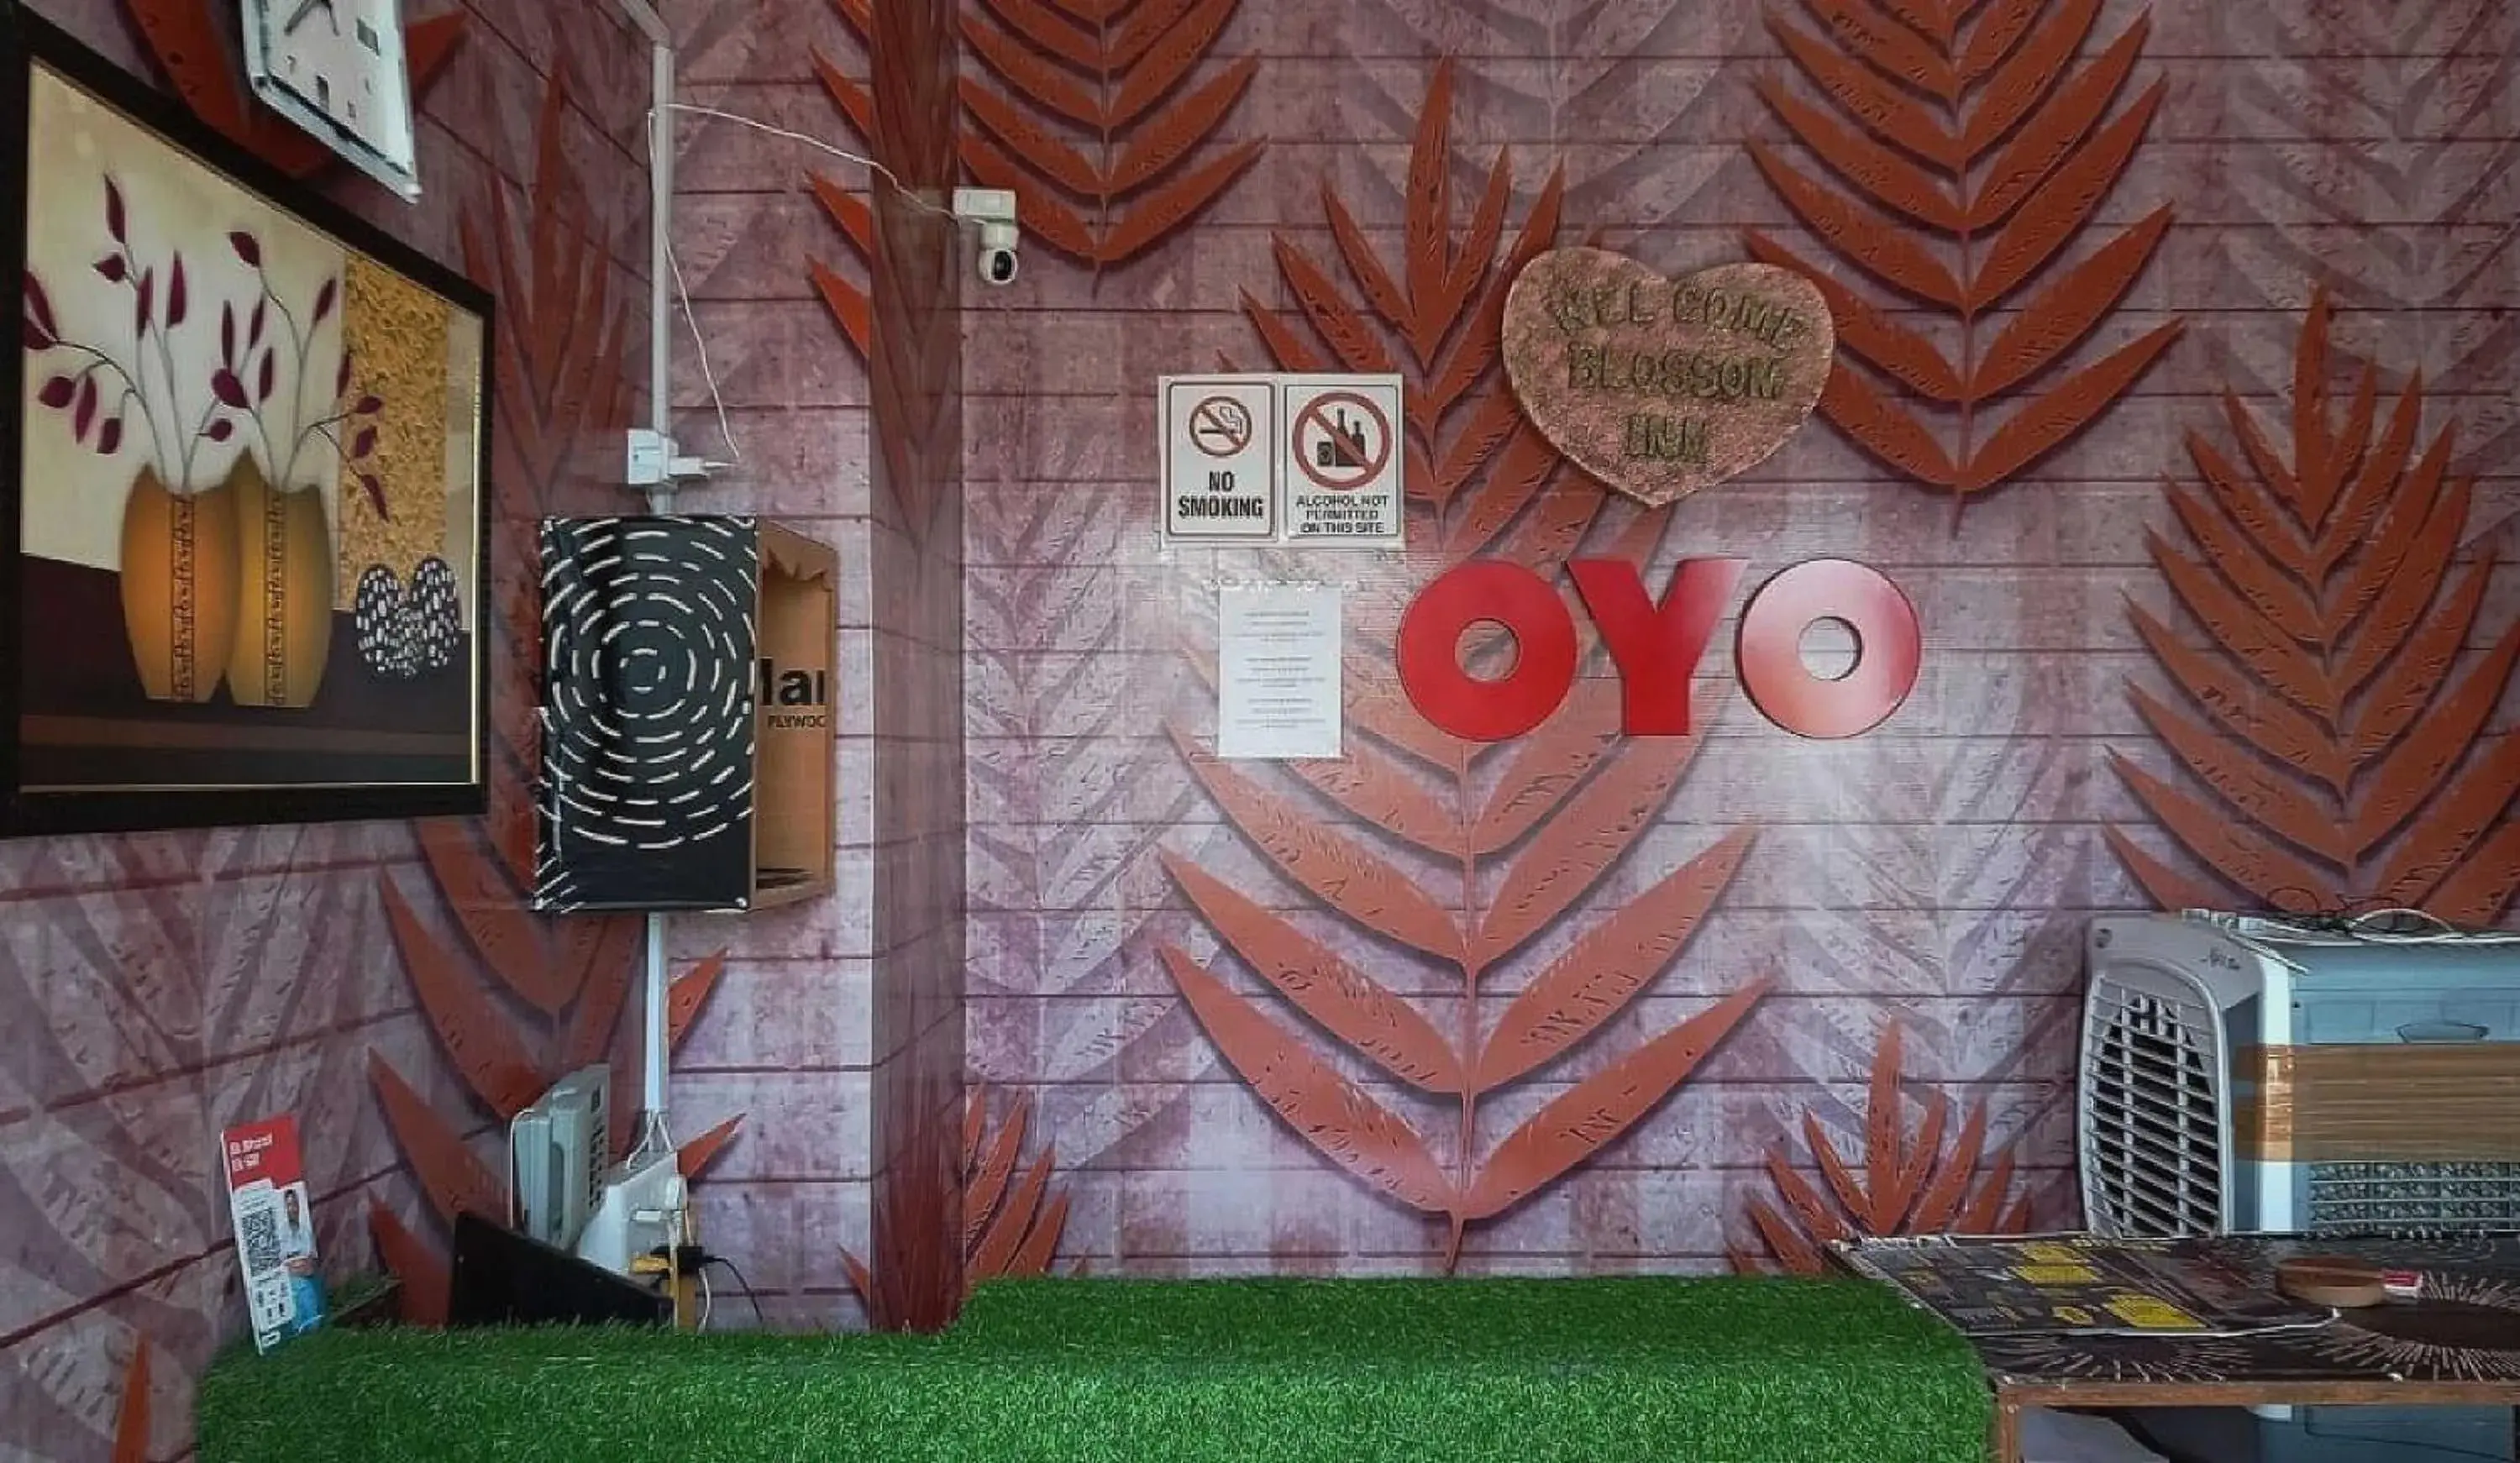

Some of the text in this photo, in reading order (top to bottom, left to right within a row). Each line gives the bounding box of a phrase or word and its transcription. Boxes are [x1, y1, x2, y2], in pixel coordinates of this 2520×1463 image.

[1567, 342, 1784, 399] BLOSSOM
[1209, 471, 1235, 491] NO
[1179, 497, 1264, 518] SMOKING
[1297, 496, 1389, 507] ALCOHOL NOT
[1306, 510, 1378, 520] PERMITTED
[1300, 522, 1385, 533] ON THIS SITE
[1396, 557, 1922, 739] OYO
